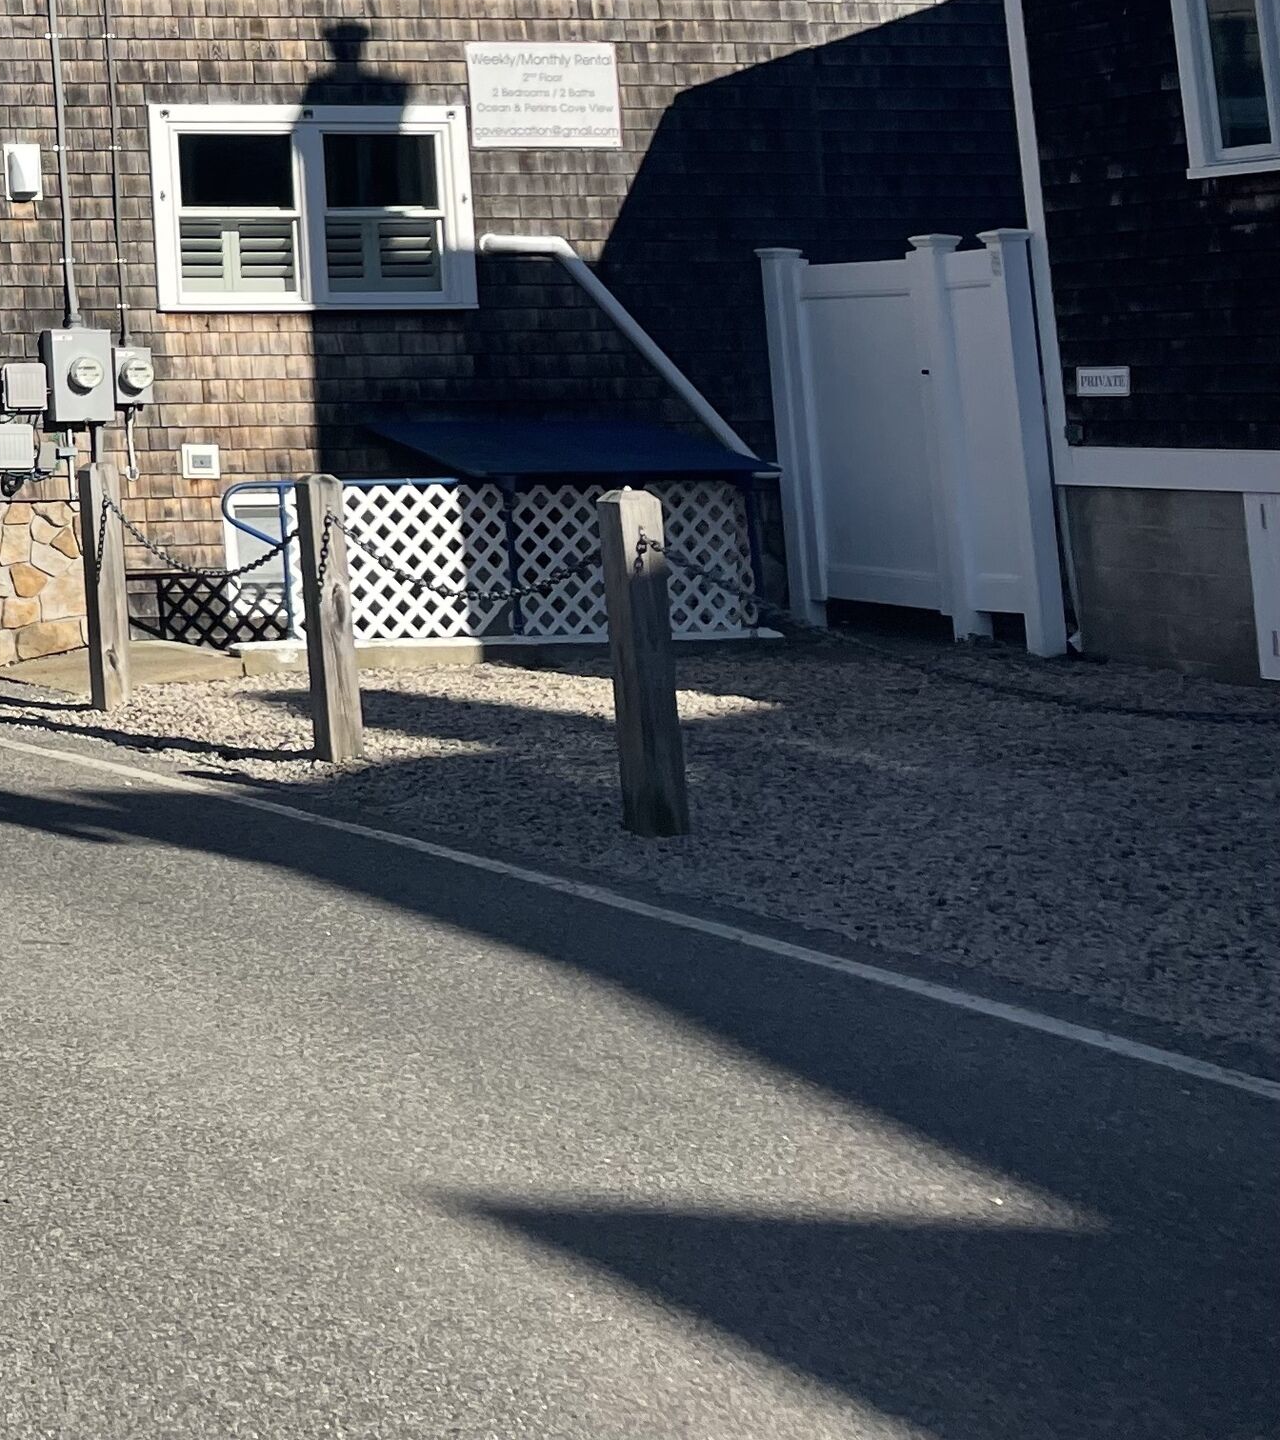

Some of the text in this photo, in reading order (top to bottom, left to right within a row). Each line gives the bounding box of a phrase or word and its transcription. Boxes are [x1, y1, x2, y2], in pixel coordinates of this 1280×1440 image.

[471, 53, 613, 68] Weekly/Monthly Rental
[539, 72, 563, 82] Floor
[502, 88, 550, 98] Bedrooms
[569, 88, 595, 98] Baths
[476, 103, 512, 113] Ocean
[559, 103, 587, 113] Cove
[588, 103, 615, 113] View
[474, 125, 619, 138] covevacation@gmail.com
[1080, 375, 1125, 387] PRIVATE
